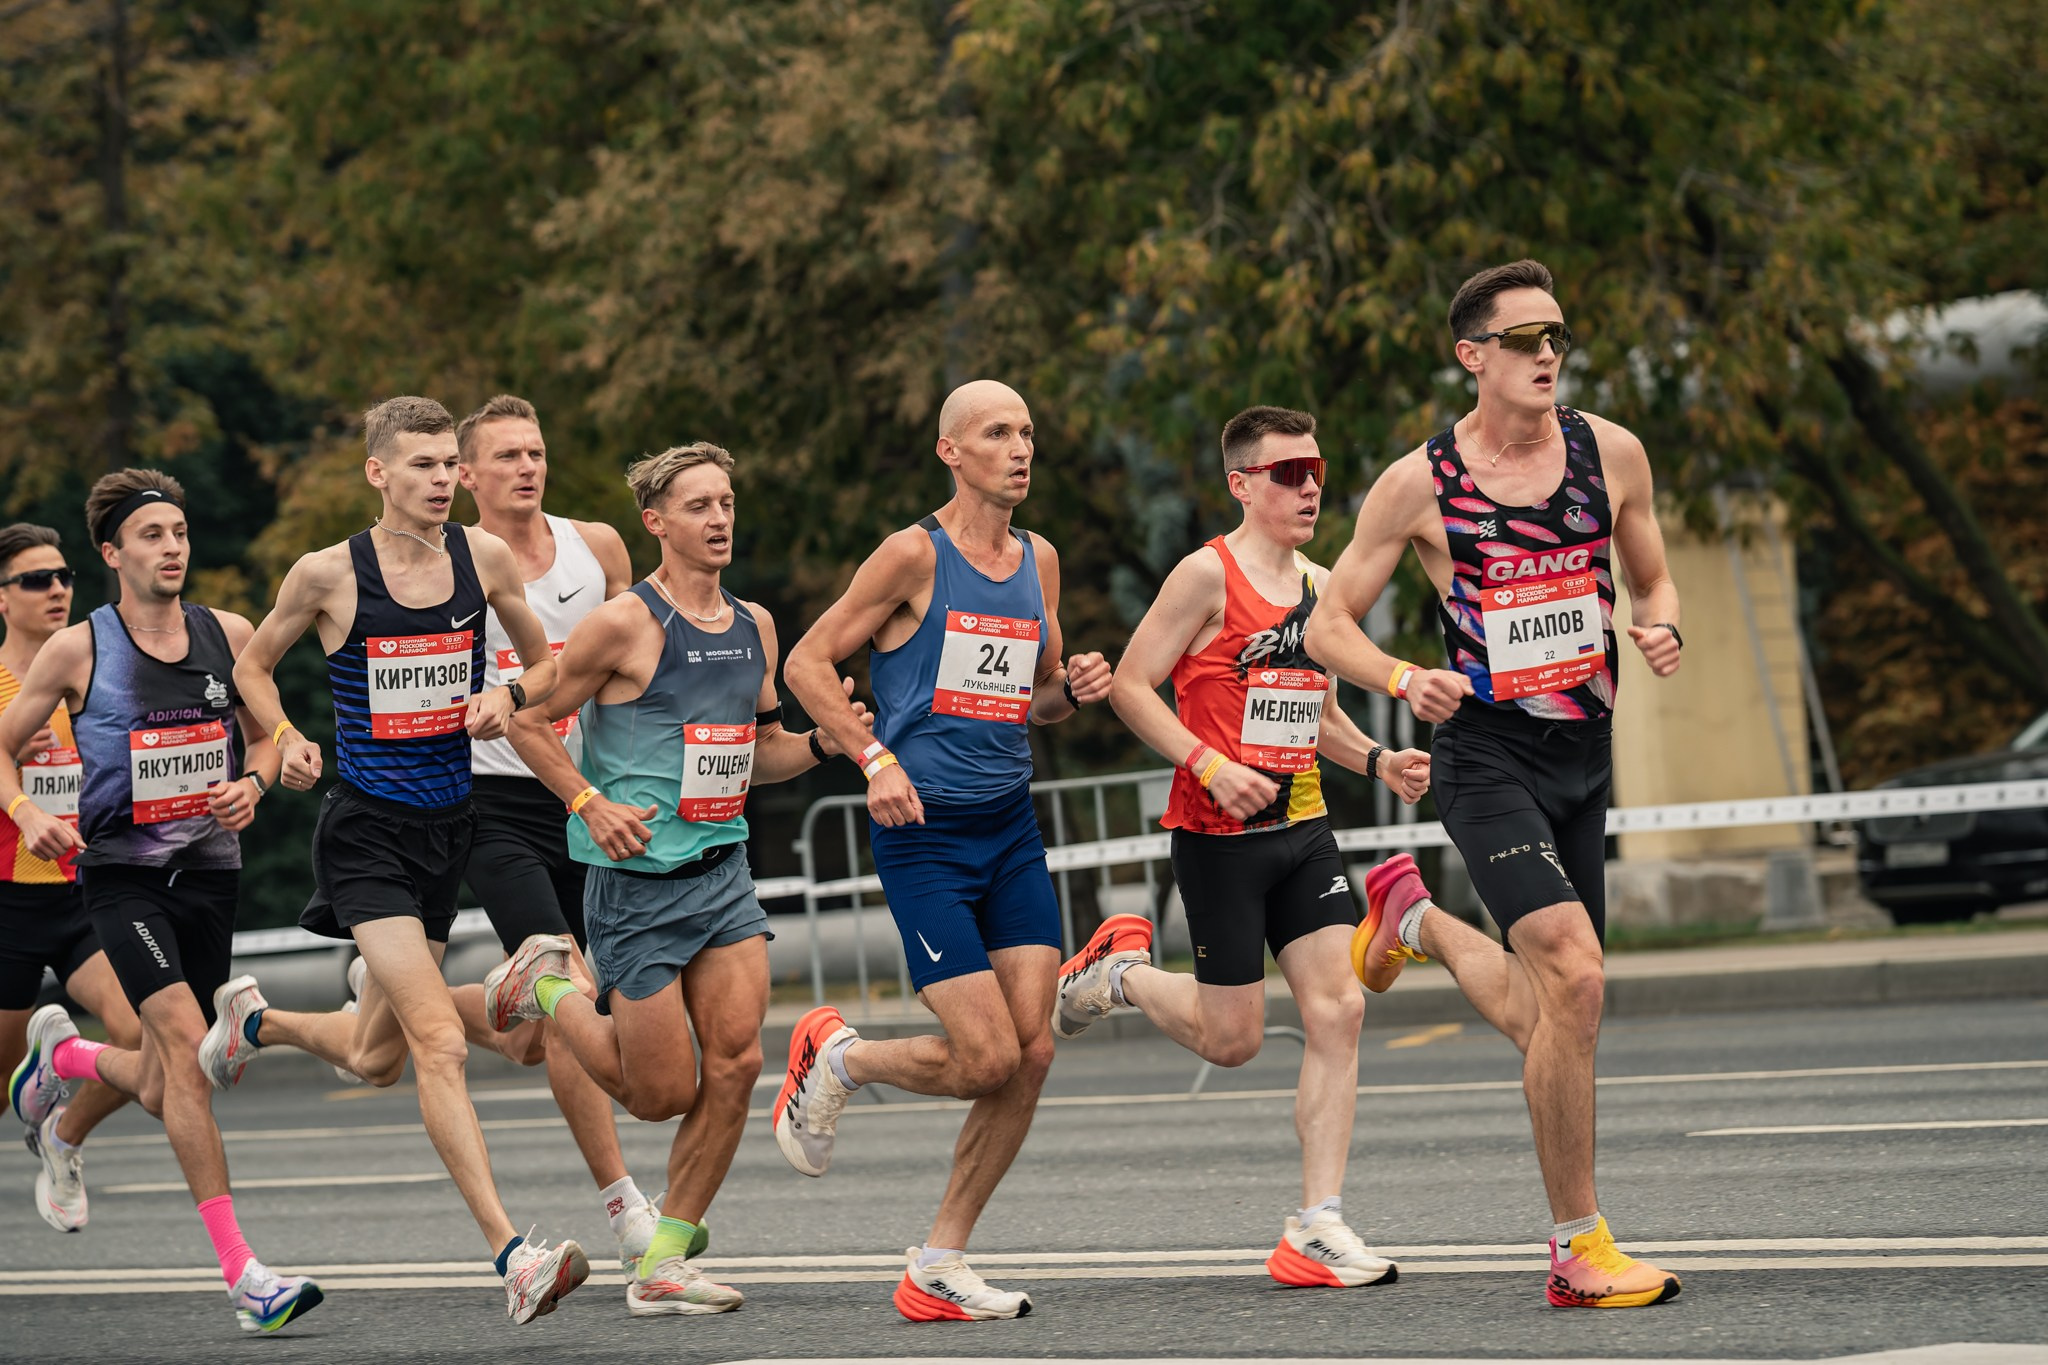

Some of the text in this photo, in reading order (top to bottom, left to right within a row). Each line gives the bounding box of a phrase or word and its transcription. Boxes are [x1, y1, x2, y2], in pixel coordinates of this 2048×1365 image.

[1487, 549, 1589, 582] GANG
[1516, 586, 1558, 598] МОСКОВСКИЙ
[1517, 594, 1548, 604] МАРАФОН
[1508, 609, 1584, 645] АГАПОВ
[977, 644, 1010, 677] 24
[1544, 650, 1556, 660] 22
[376, 662, 468, 690] КИРГИЗОВ
[962, 679, 1017, 694] ЛУКЬЯНЦЕВ
[420, 699, 432, 708] 23
[146, 708, 202, 722] ADIXION
[1290, 736, 1299, 744] 27
[138, 749, 224, 780] ЯКУТИЛОВ
[698, 752, 750, 780] СУЩЕНЯ
[178, 785, 189, 793] 20
[721, 786, 729, 795] 11
[1490, 844, 1531, 863] PWRD
[132, 921, 170, 969] ADIXION
